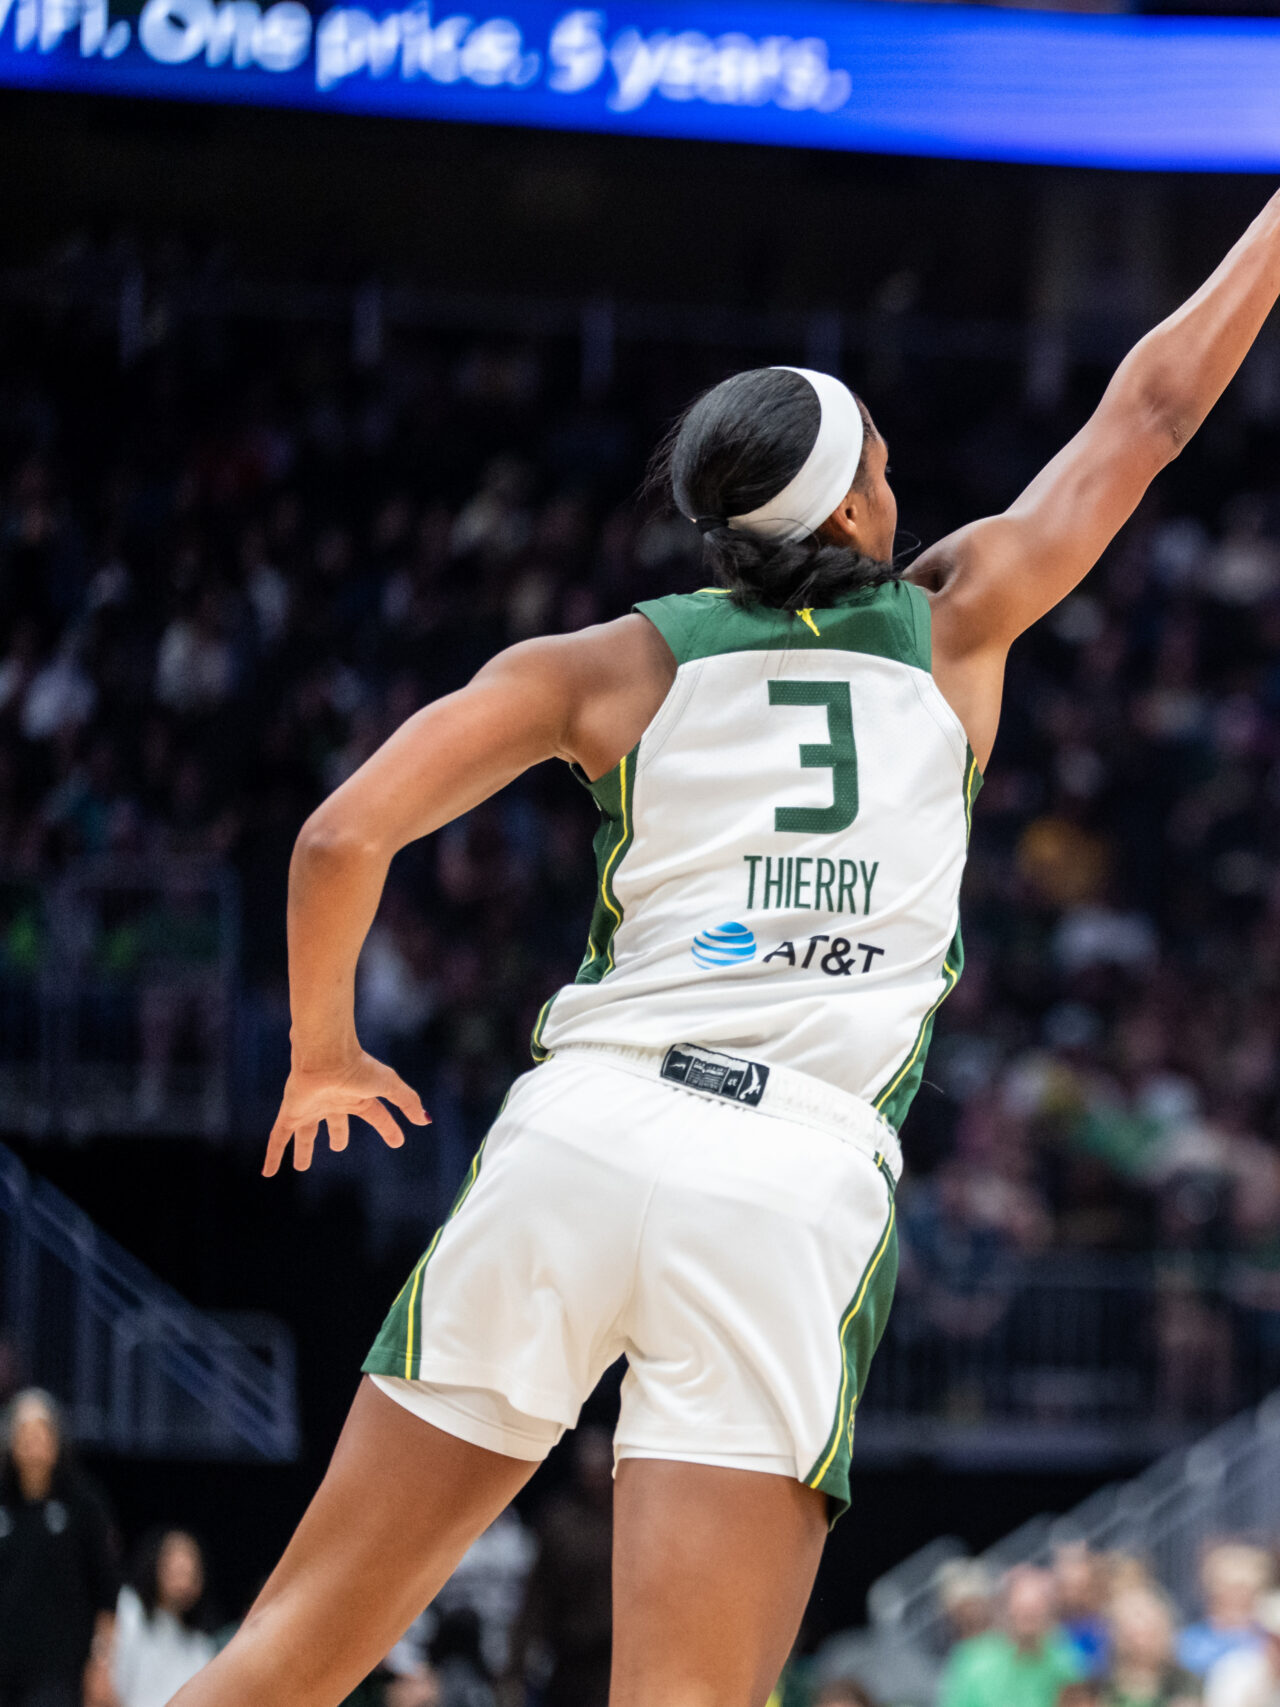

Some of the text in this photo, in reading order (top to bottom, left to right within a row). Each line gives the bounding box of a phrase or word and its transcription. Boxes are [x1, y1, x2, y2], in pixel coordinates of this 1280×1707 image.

[139, 0, 312, 72] One
[548, 9, 605, 94] 5
[768, 680, 858, 833] 3
[744, 855, 879, 915] THIERRY
[762, 935, 885, 976] AT&T
